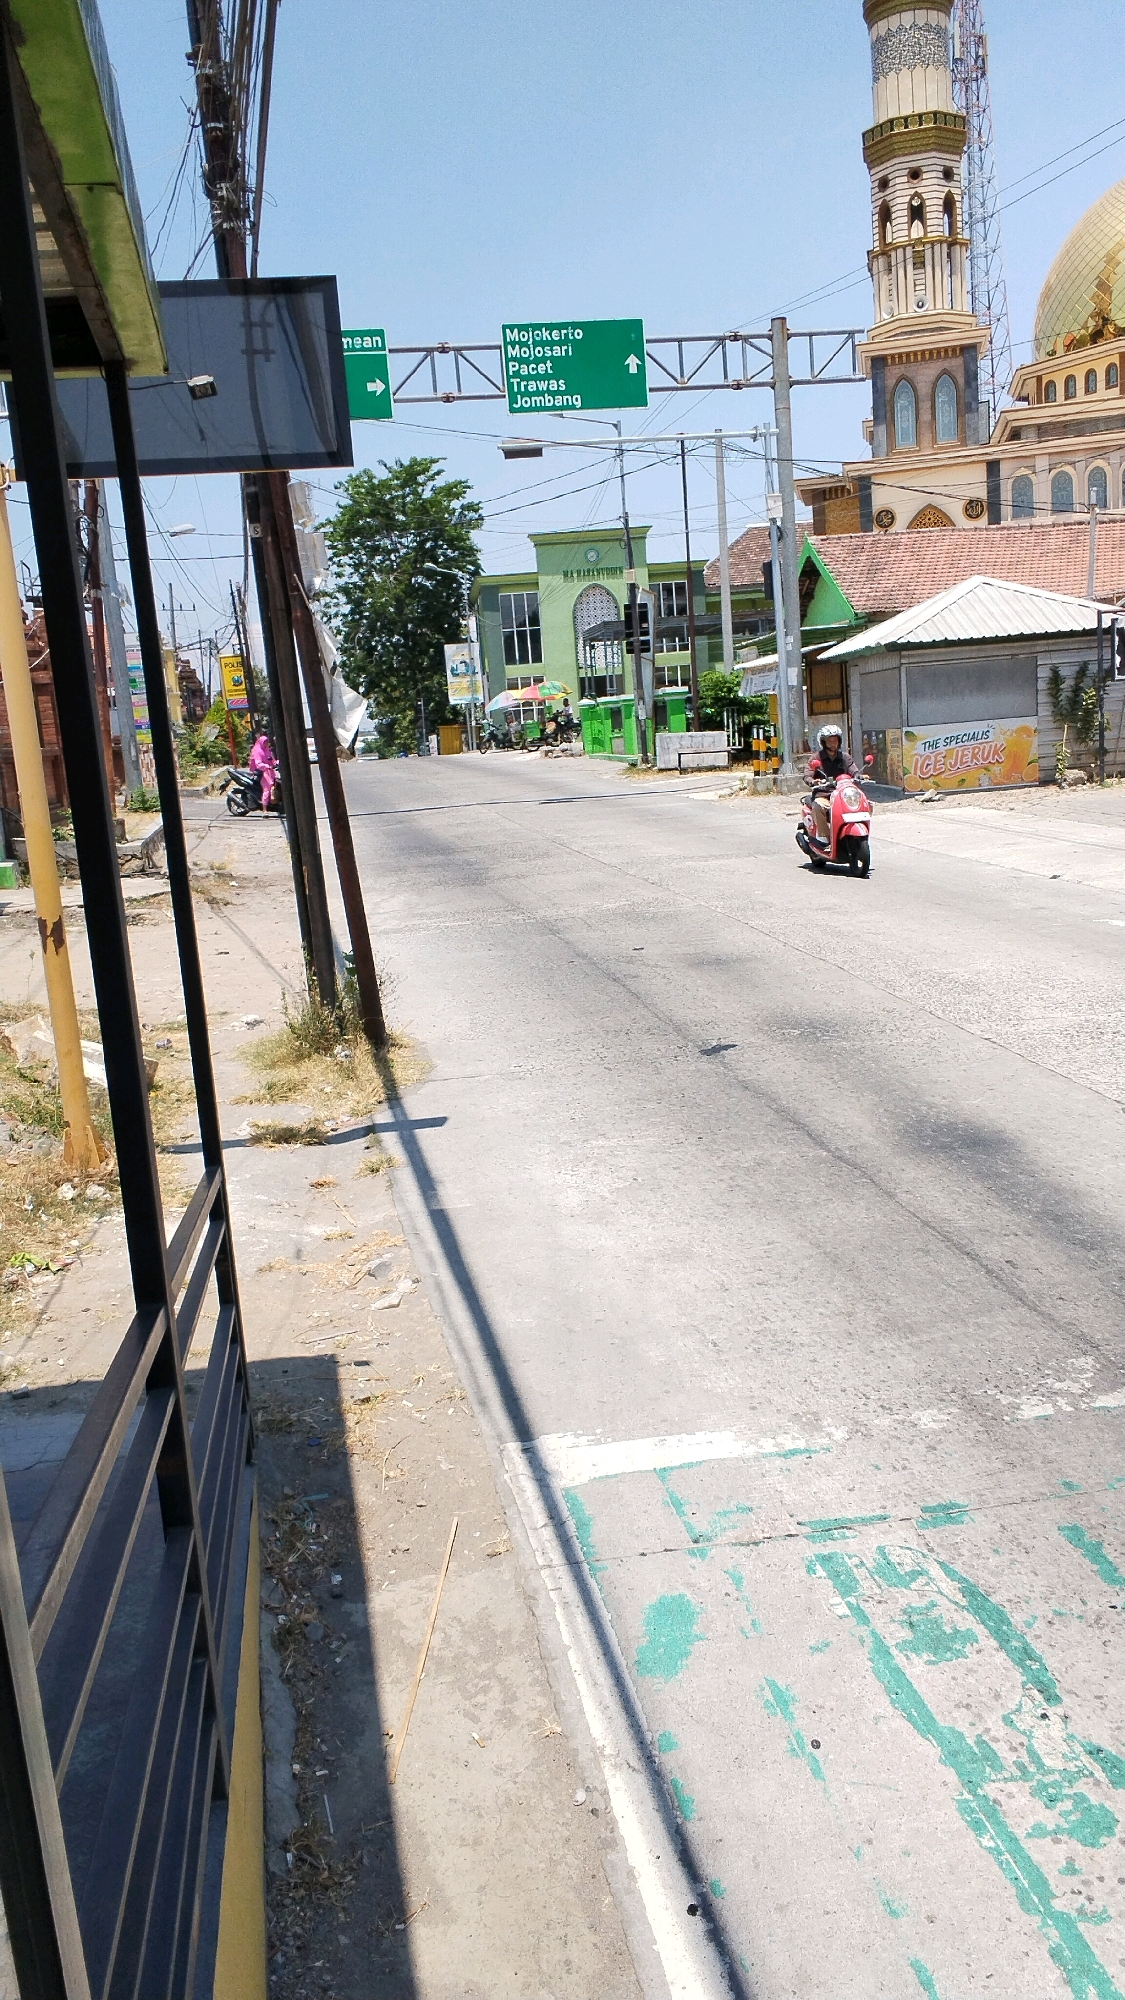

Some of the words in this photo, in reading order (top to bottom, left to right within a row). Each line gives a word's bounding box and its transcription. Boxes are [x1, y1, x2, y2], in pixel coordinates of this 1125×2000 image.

[505, 326, 583, 345] Mojokerto
[507, 343, 573, 361] Mojosari
[508, 359, 554, 376] Pacet
[510, 378, 566, 392] Trawas
[512, 393, 582, 409] Jombang
[223, 661, 243, 669] POLIS
[921, 738, 941, 752] THE
[943, 729, 990, 748] SPECIALIS
[913, 751, 946, 778] ICE
[947, 742, 1006, 771] JERUK
